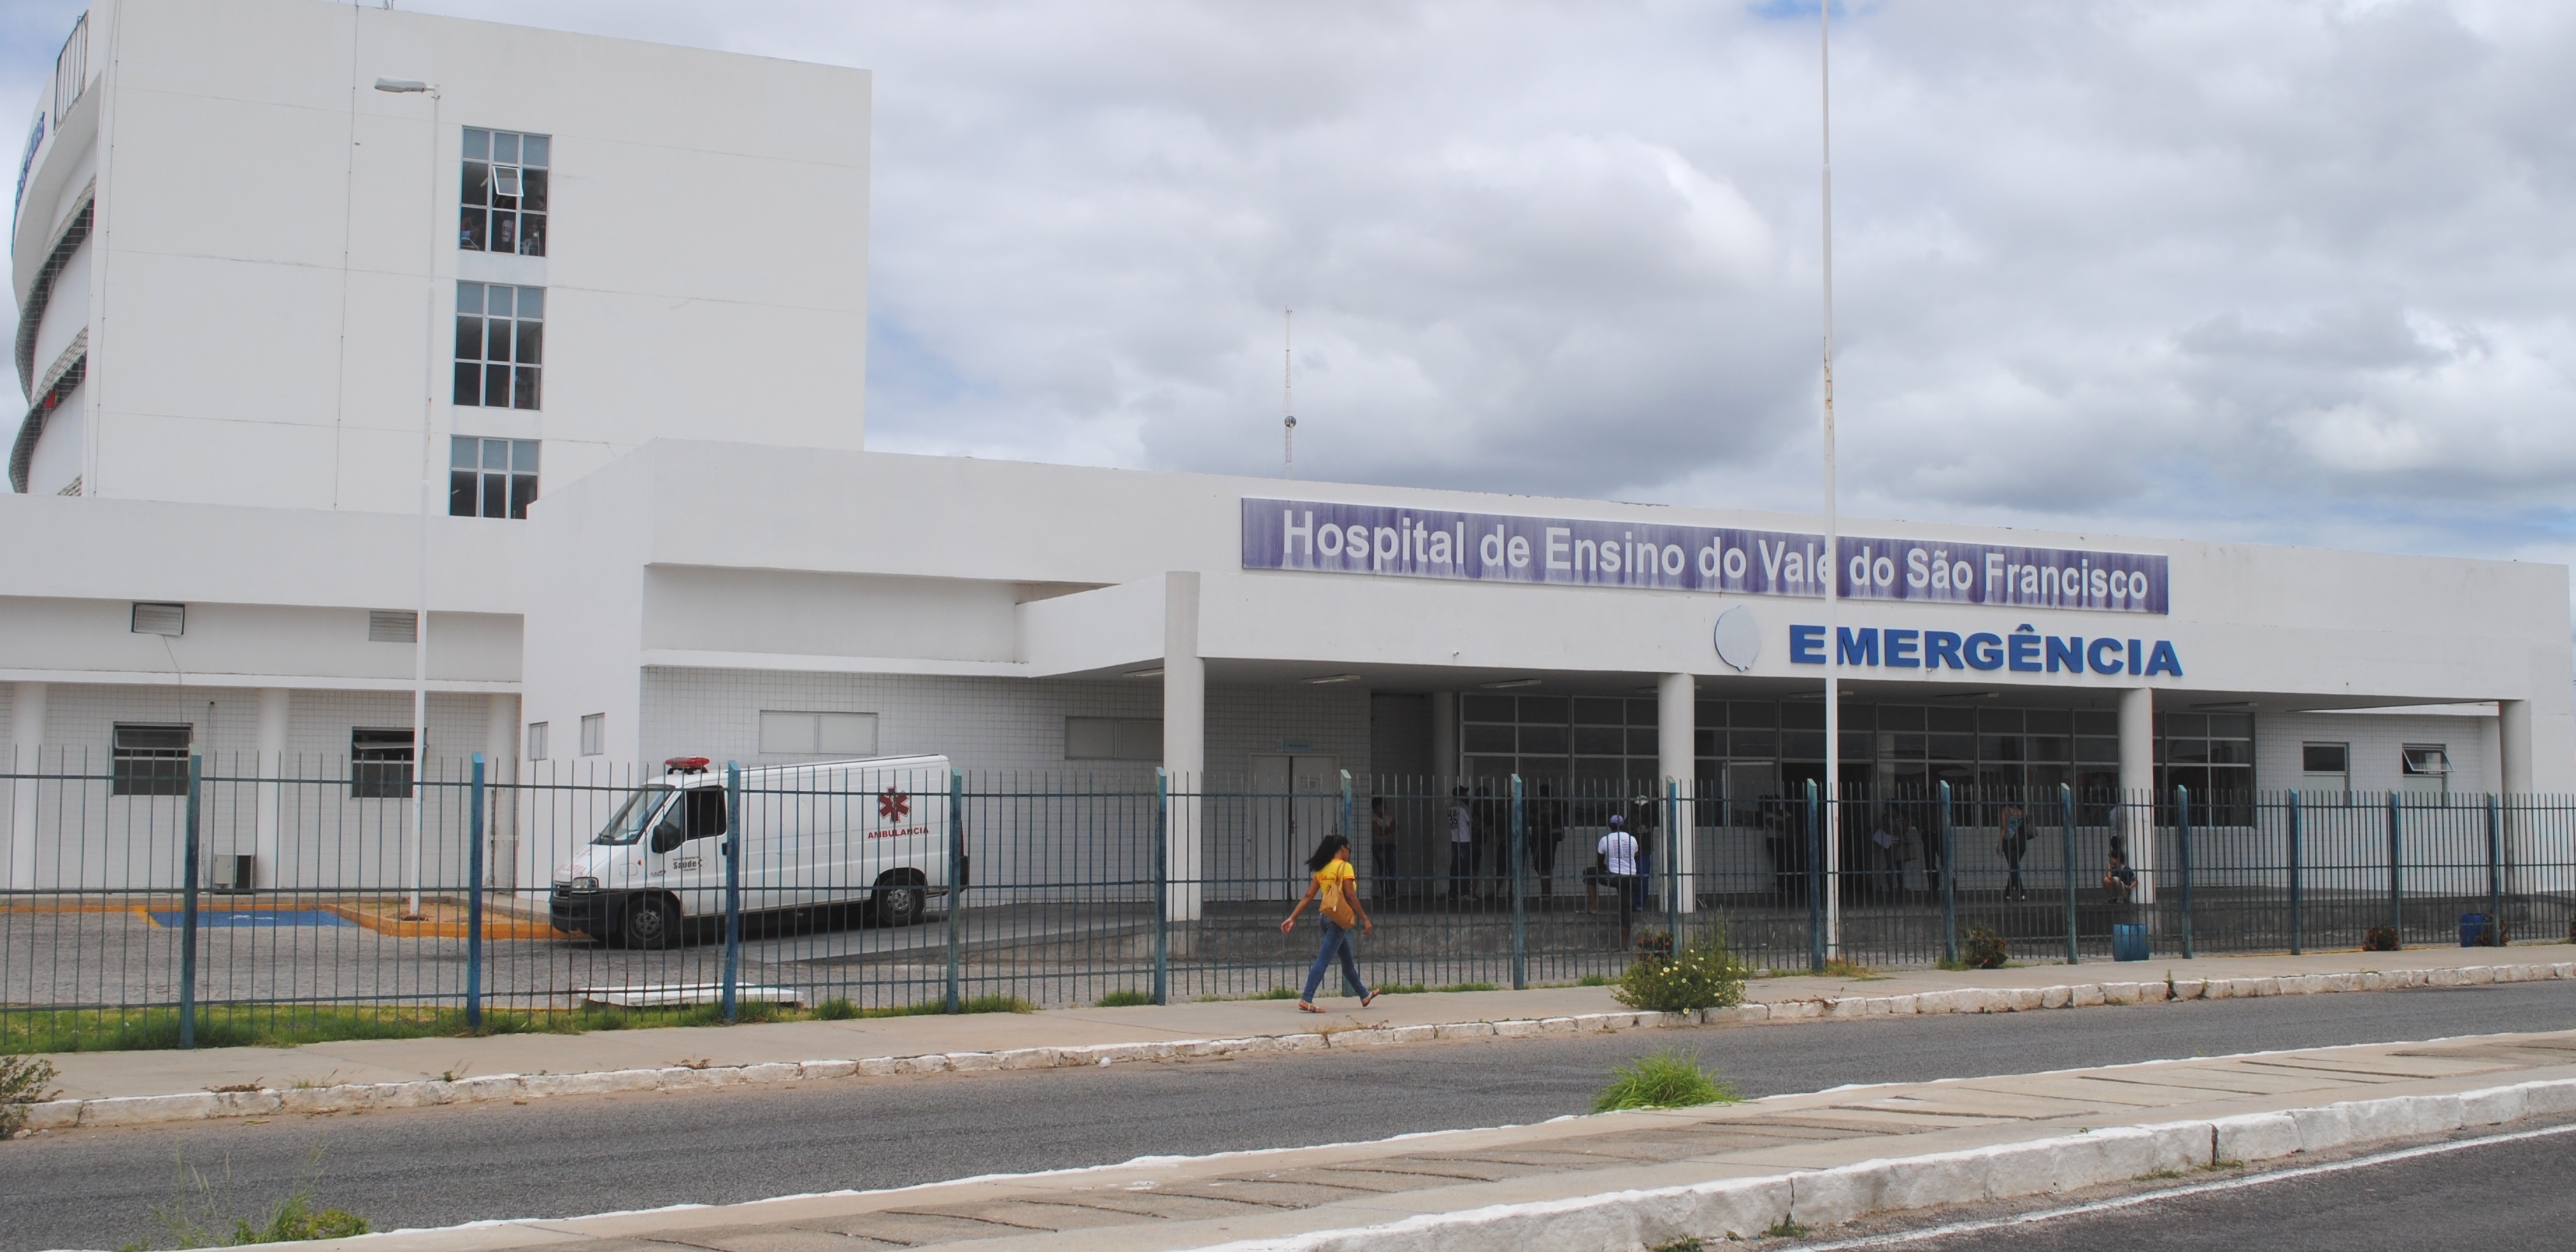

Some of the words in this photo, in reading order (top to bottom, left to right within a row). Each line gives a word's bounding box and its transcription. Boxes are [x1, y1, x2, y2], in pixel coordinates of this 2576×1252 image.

[1282, 508, 1464, 571] Hospital
[1480, 525, 1531, 567] de
[1545, 527, 1685, 576] Ensino
[1698, 536, 1747, 578] do
[1849, 546, 1894, 587] do
[1906, 548, 1973, 590] São
[1985, 553, 2147, 599] Francisco
[1789, 623, 2183, 676] EMERGÊNCIA
